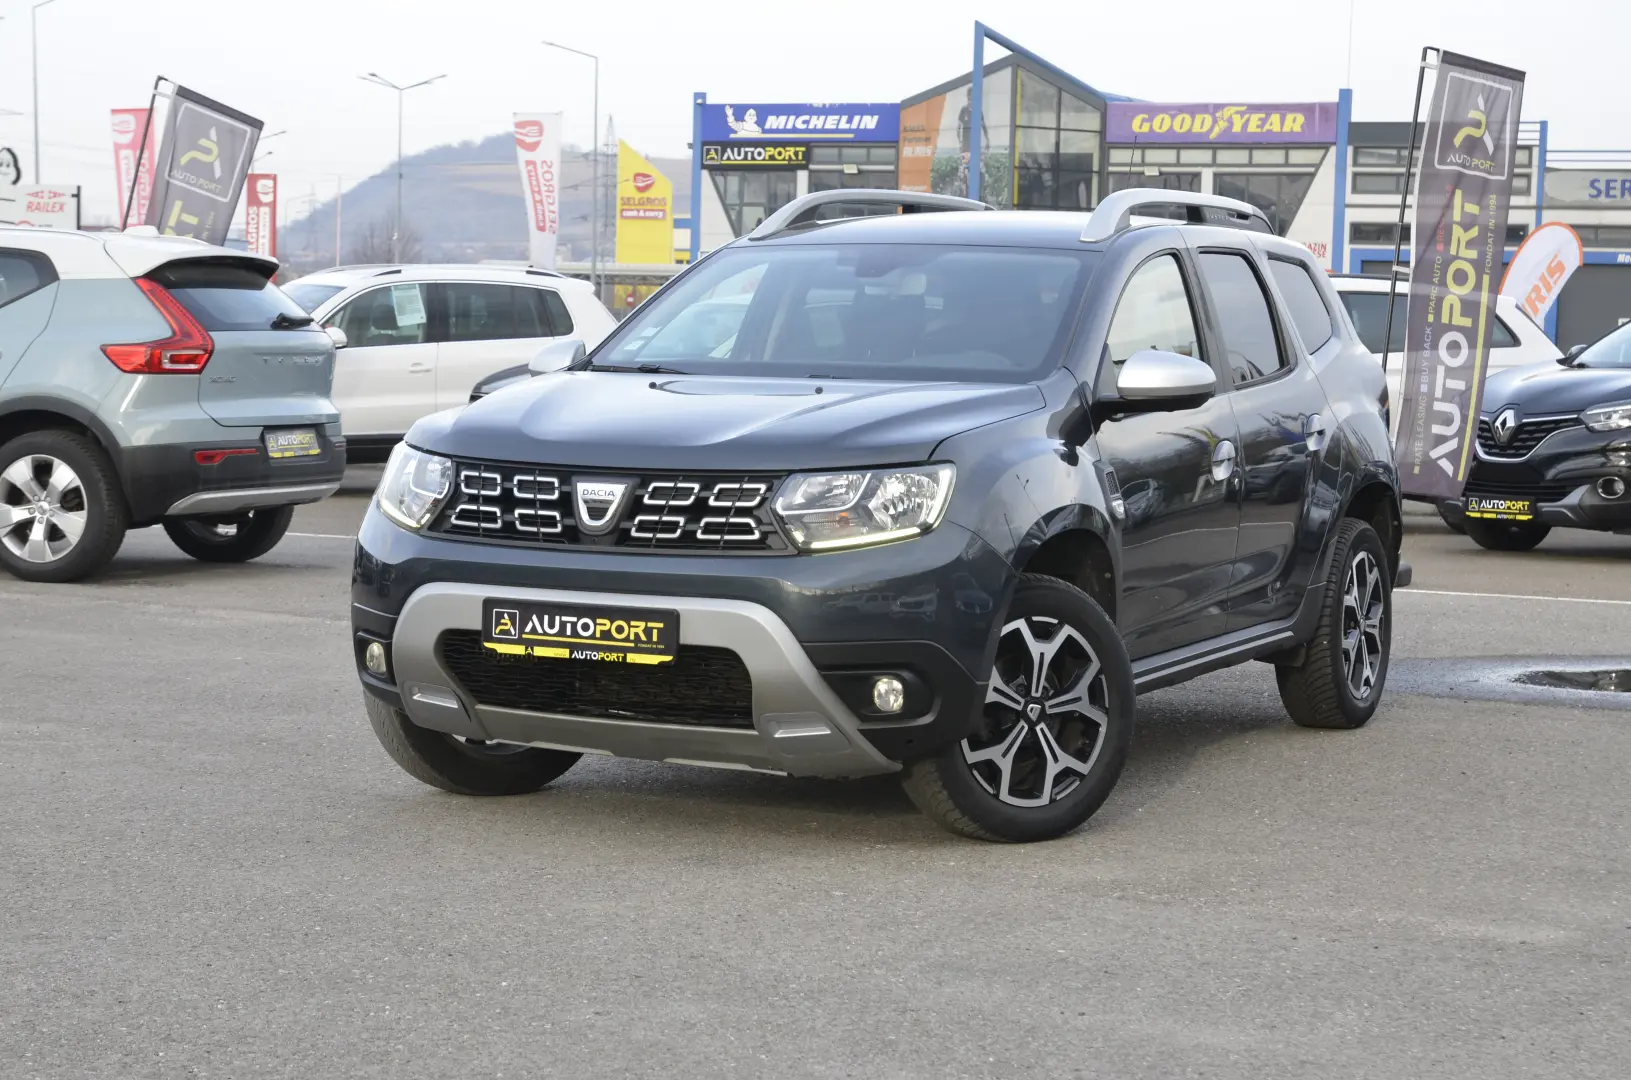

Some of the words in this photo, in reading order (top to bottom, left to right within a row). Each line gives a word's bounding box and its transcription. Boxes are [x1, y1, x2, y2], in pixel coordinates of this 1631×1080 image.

[764, 115, 879, 130] MICHELIN
[722, 146, 806, 161] AUTOPORT
[1447, 153, 1470, 166] AUTO
[1472, 158, 1495, 173] PORT
[620, 196, 667, 206] SELGROS
[1488, 219, 1496, 230] IN
[1484, 232, 1495, 274] FONDAT
[1432, 255, 1443, 284] AUTO
[1428, 286, 1438, 313] PARC
[1422, 326, 1433, 357] BACK
[1429, 188, 1480, 478] AUTOPORT
[1420, 361, 1430, 383] BUY
[1416, 395, 1427, 439] LEASING
[278, 433, 314, 446] AUTOPORT
[1414, 441, 1424, 465] RATE
[582, 489, 615, 497] DACIA
[1480, 499, 1530, 511] AUTOPORT
[524, 613, 664, 642] AUTOPORT
[571, 650, 624, 662] AUTOPORT
